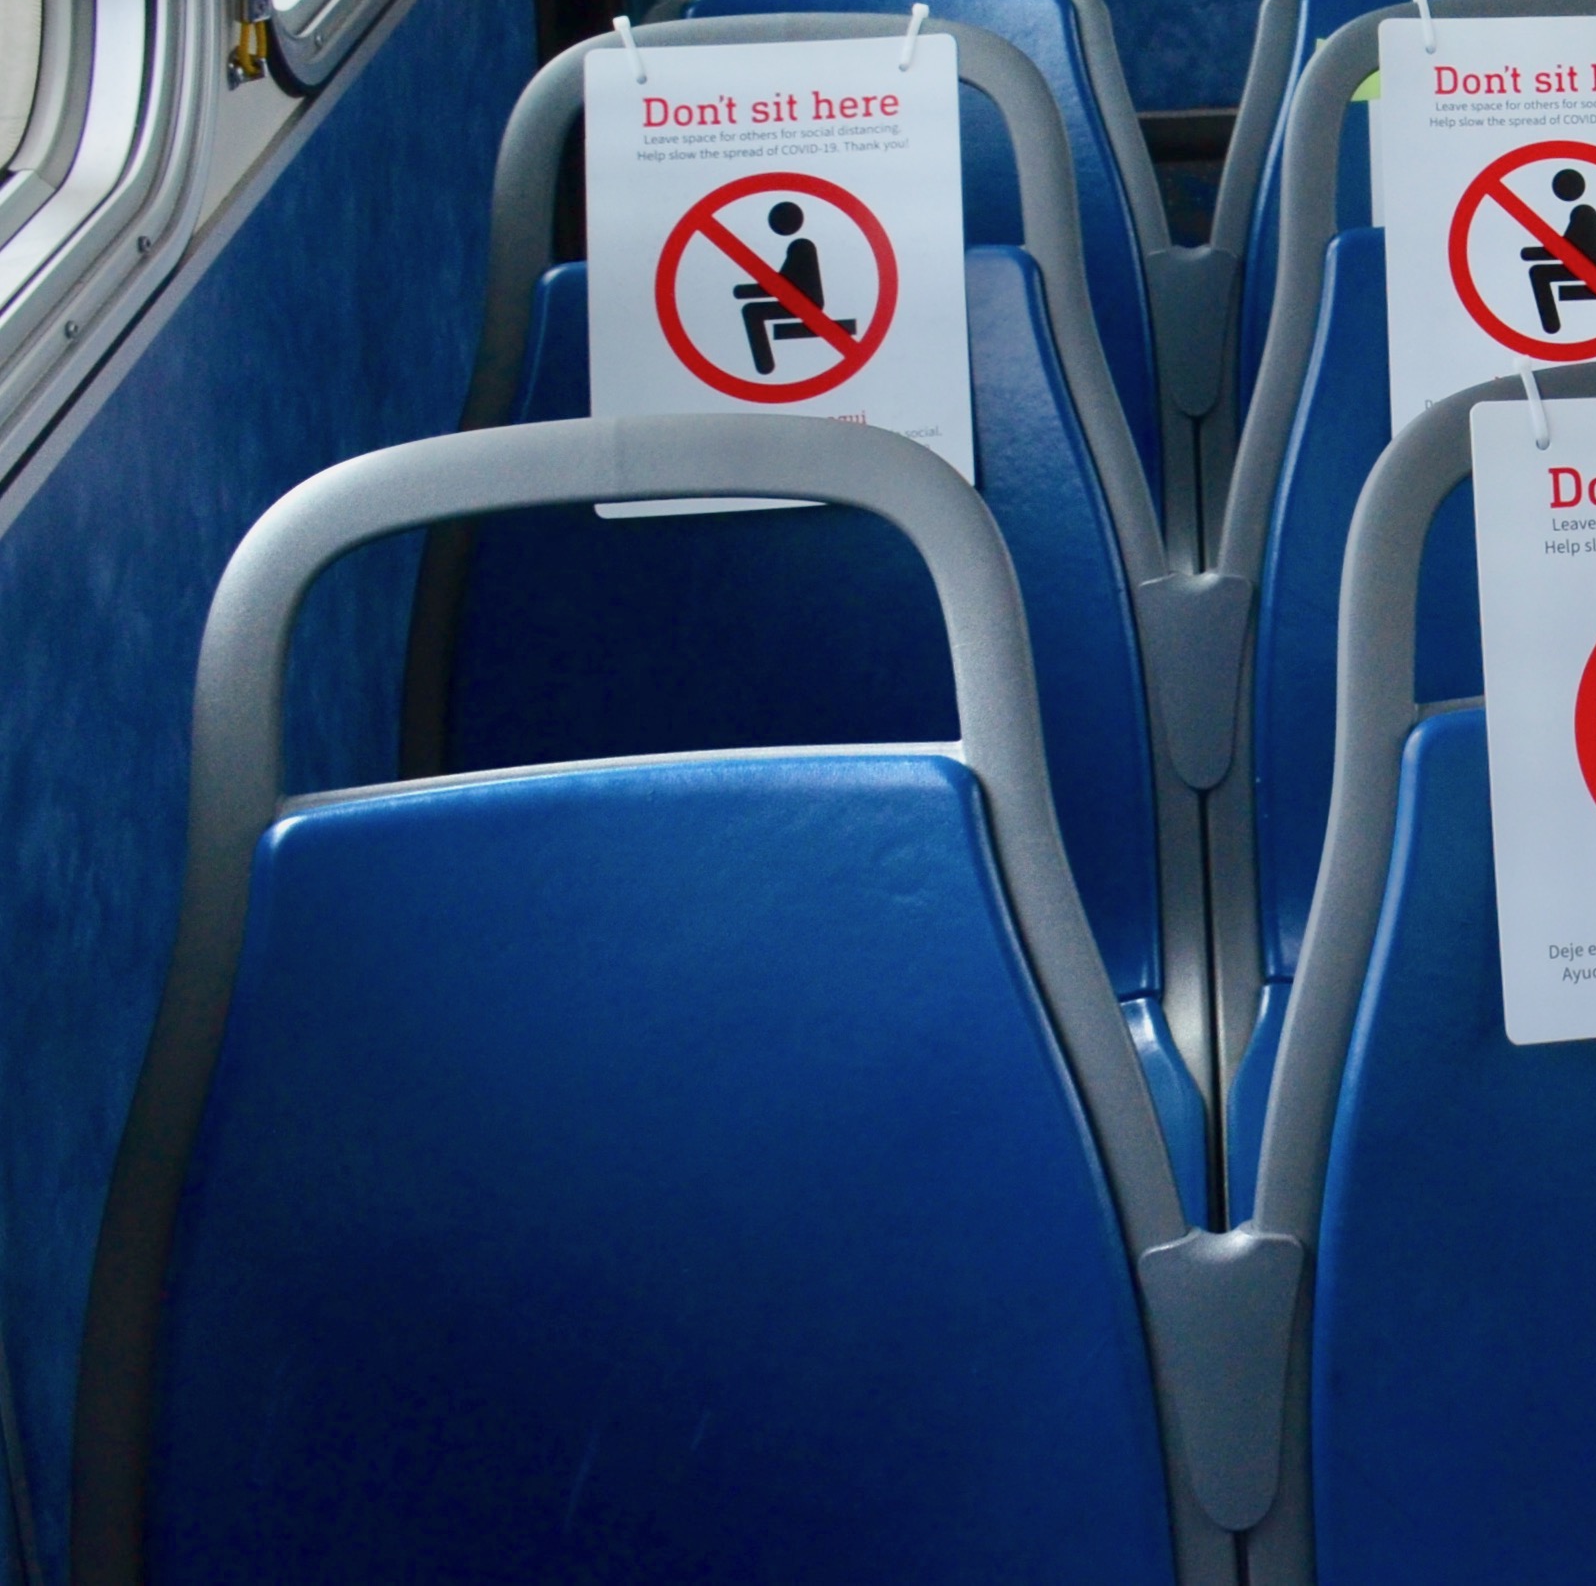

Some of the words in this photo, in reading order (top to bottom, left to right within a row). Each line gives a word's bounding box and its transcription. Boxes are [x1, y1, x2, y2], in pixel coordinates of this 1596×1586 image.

[1434, 64, 1522, 96] Don't
[1534, 63, 1579, 94] sit
[643, 94, 738, 128] Don't
[751, 91, 799, 124] sit
[810, 90, 900, 122] here
[1436, 100, 1469, 112] Leave
[1471, 102, 1504, 113] space
[1505, 99, 1522, 110] for
[1524, 99, 1560, 110] others
[1562, 98, 1578, 110] for
[1430, 115, 1457, 129] Help
[1459, 116, 1486, 127] slow
[1487, 115, 1507, 127] the
[1508, 114, 1547, 128] spread
[1549, 114, 1561, 126] of
[644, 133, 680, 145] Leave
[682, 133, 718, 146] space
[719, 130, 737, 142] for
[739, 129, 778, 142] others
[780, 128, 798, 140] for
[800, 126, 835, 139] social
[837, 123, 903, 137] distancing.
[638, 149, 667, 163] Help
[669, 149, 698, 161] slow
[699, 147, 720, 160] the
[722, 145, 764, 160] spread
[766, 144, 779, 157] of
[780, 143, 841, 156] COVID-19.
[843, 140, 881, 153] Thank
[883, 137, 910, 153] you!
[1552, 517, 1596, 532] Leave
[1544, 538, 1582, 557] Help
[1548, 942, 1585, 963] Deje
